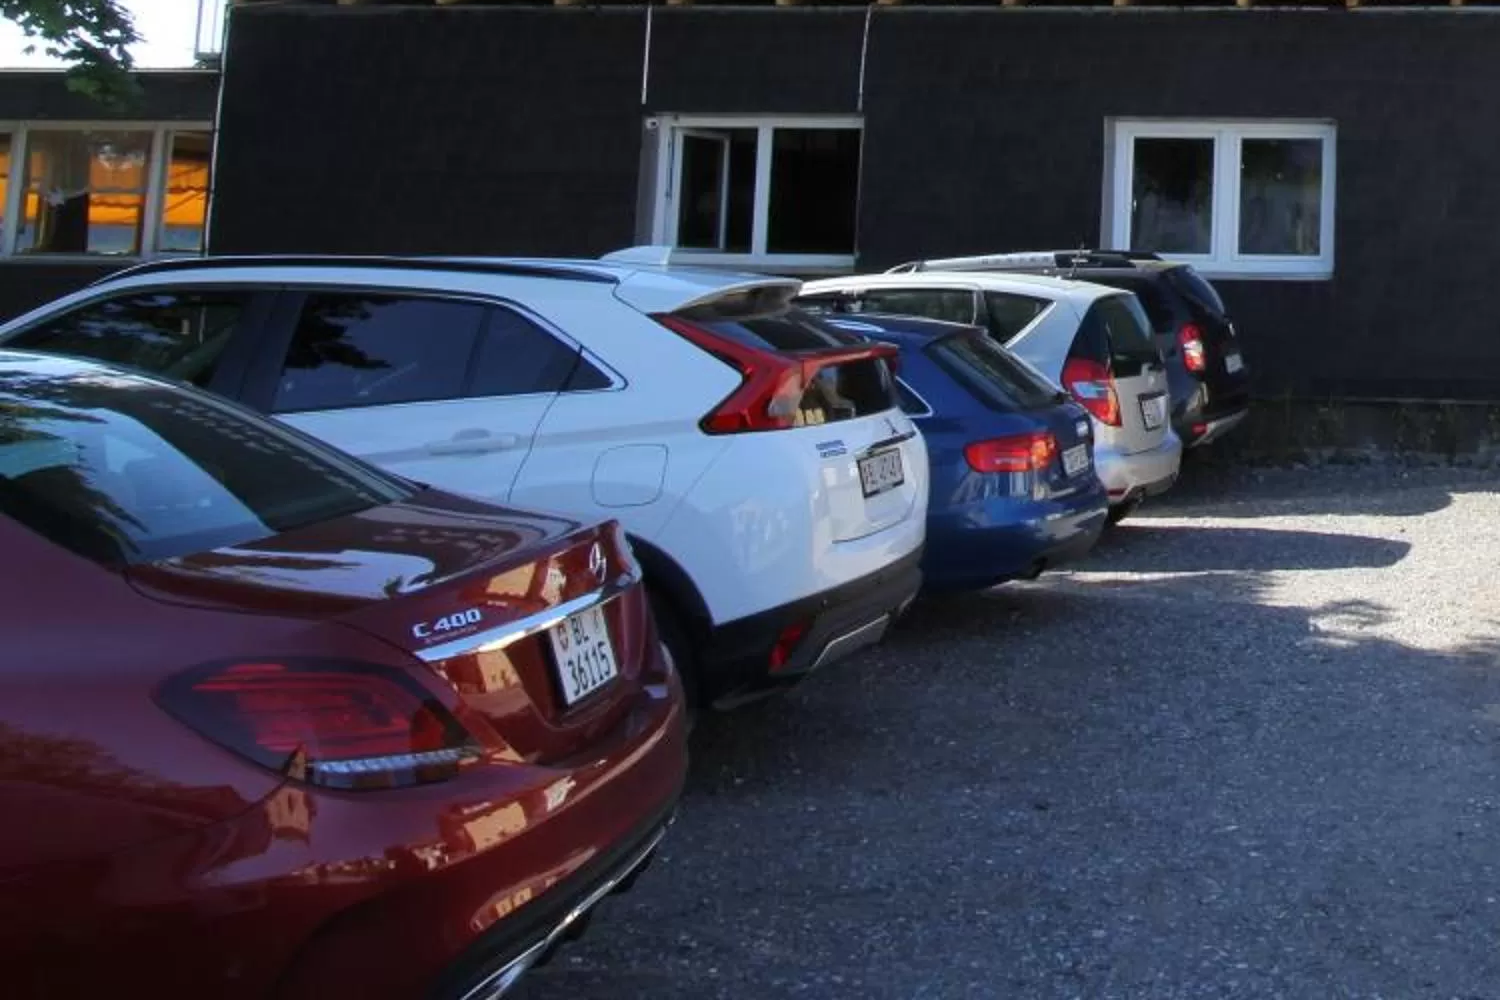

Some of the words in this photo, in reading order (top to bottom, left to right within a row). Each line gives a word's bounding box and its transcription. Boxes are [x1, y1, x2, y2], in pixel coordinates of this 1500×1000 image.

[412, 621, 432, 639] C
[433, 608, 481, 631] 400
[571, 615, 589, 646] BL
[567, 641, 611, 697] 36115
